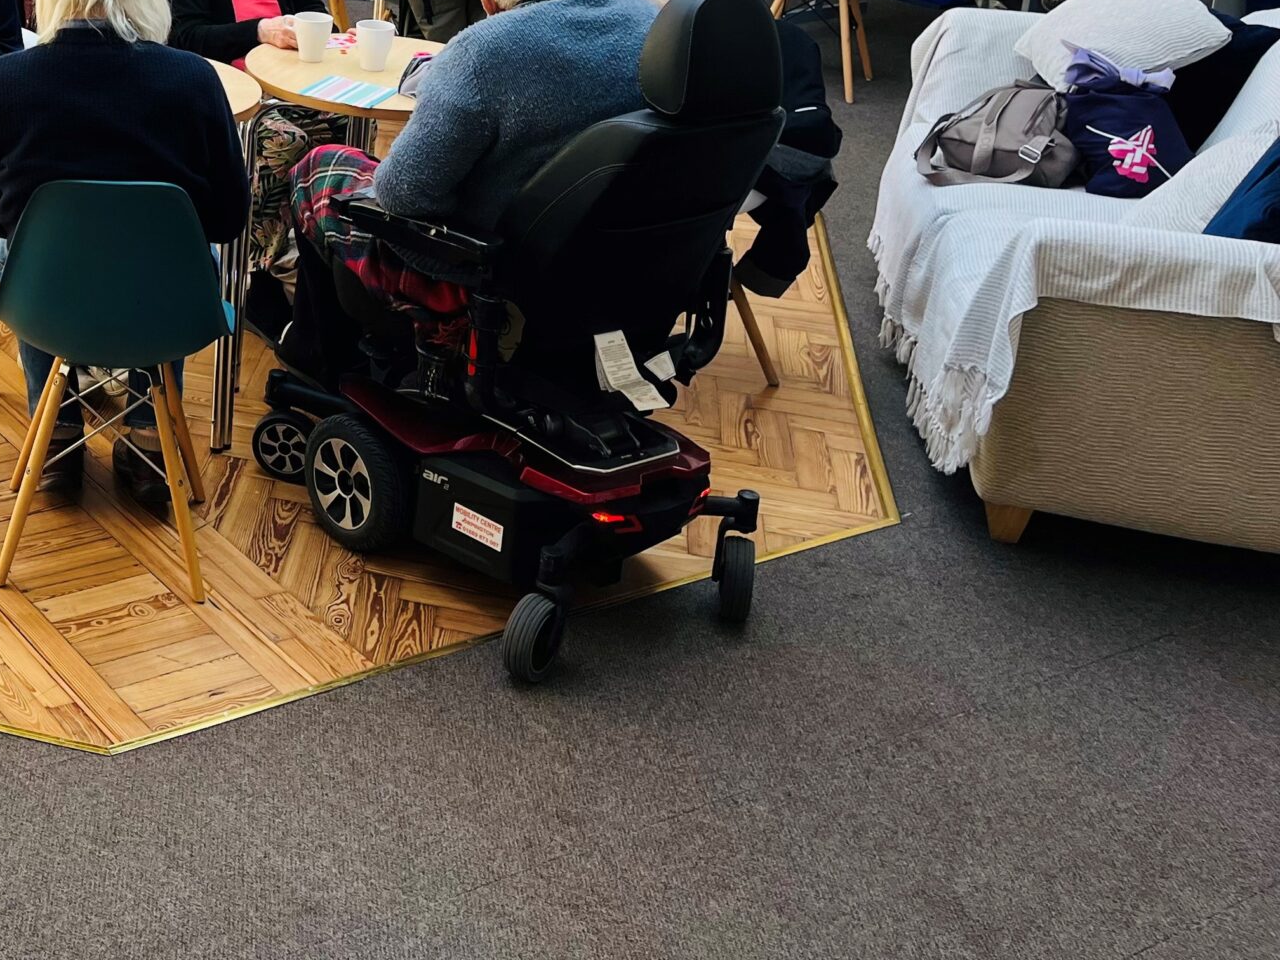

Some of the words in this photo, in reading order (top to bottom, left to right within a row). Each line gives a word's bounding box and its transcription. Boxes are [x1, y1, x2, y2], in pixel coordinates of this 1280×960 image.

[423, 469, 448, 484] air
[455, 506, 480, 522] MOBILITY
[480, 518, 503, 534] CENTRE
